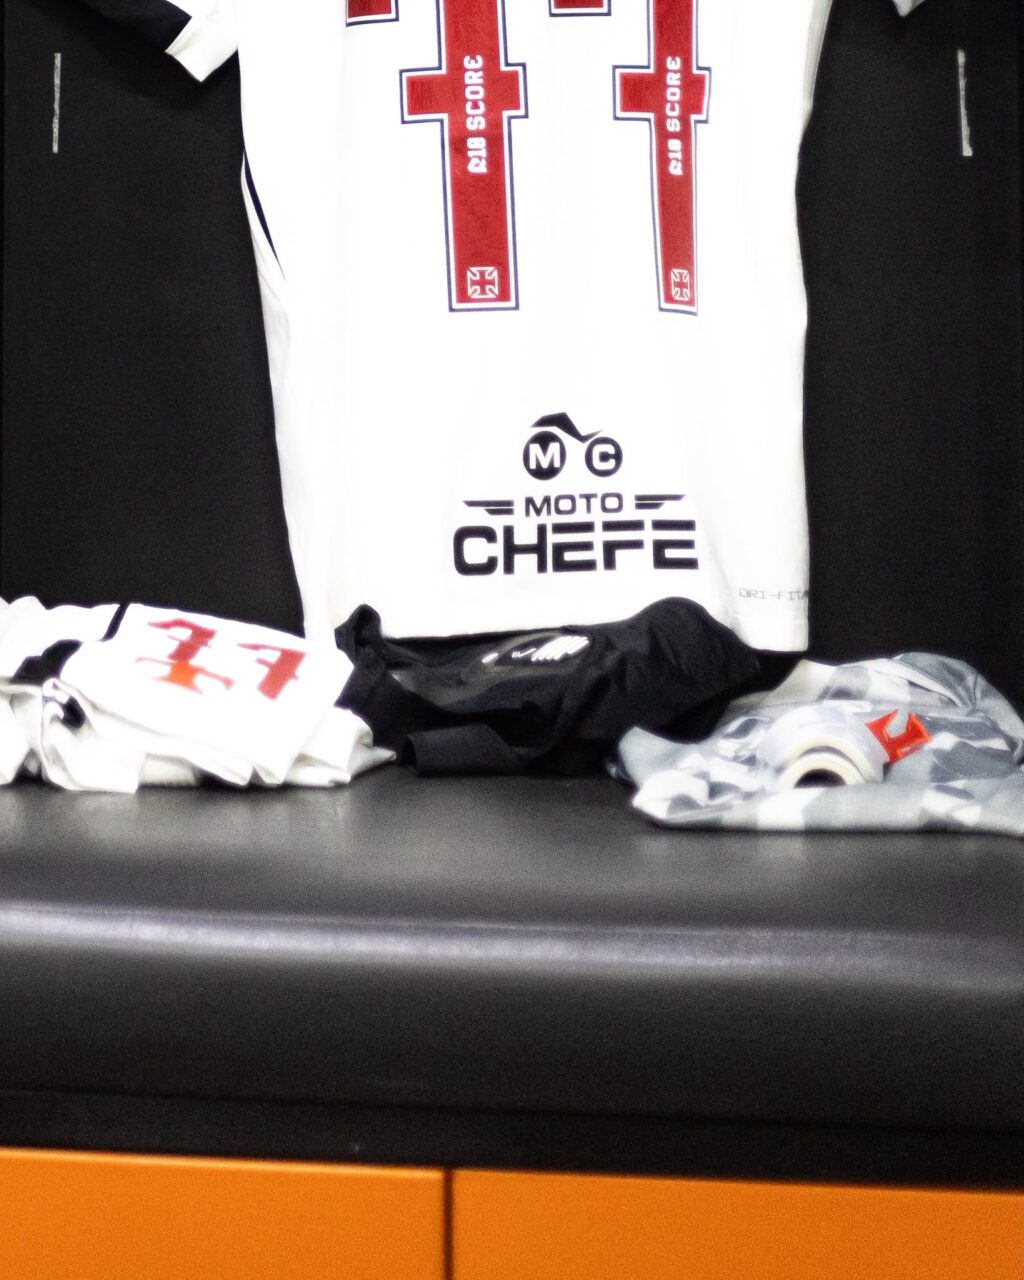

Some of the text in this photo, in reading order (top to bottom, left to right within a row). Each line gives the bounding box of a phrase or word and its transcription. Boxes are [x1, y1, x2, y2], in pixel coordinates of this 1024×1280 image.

[464, 54, 486, 130] SCORE
[666, 55, 682, 132] SCORE
[529, 442, 616, 471] M C
[524, 492, 624, 518] MOTO
[453, 520, 699, 576] CHEFE
